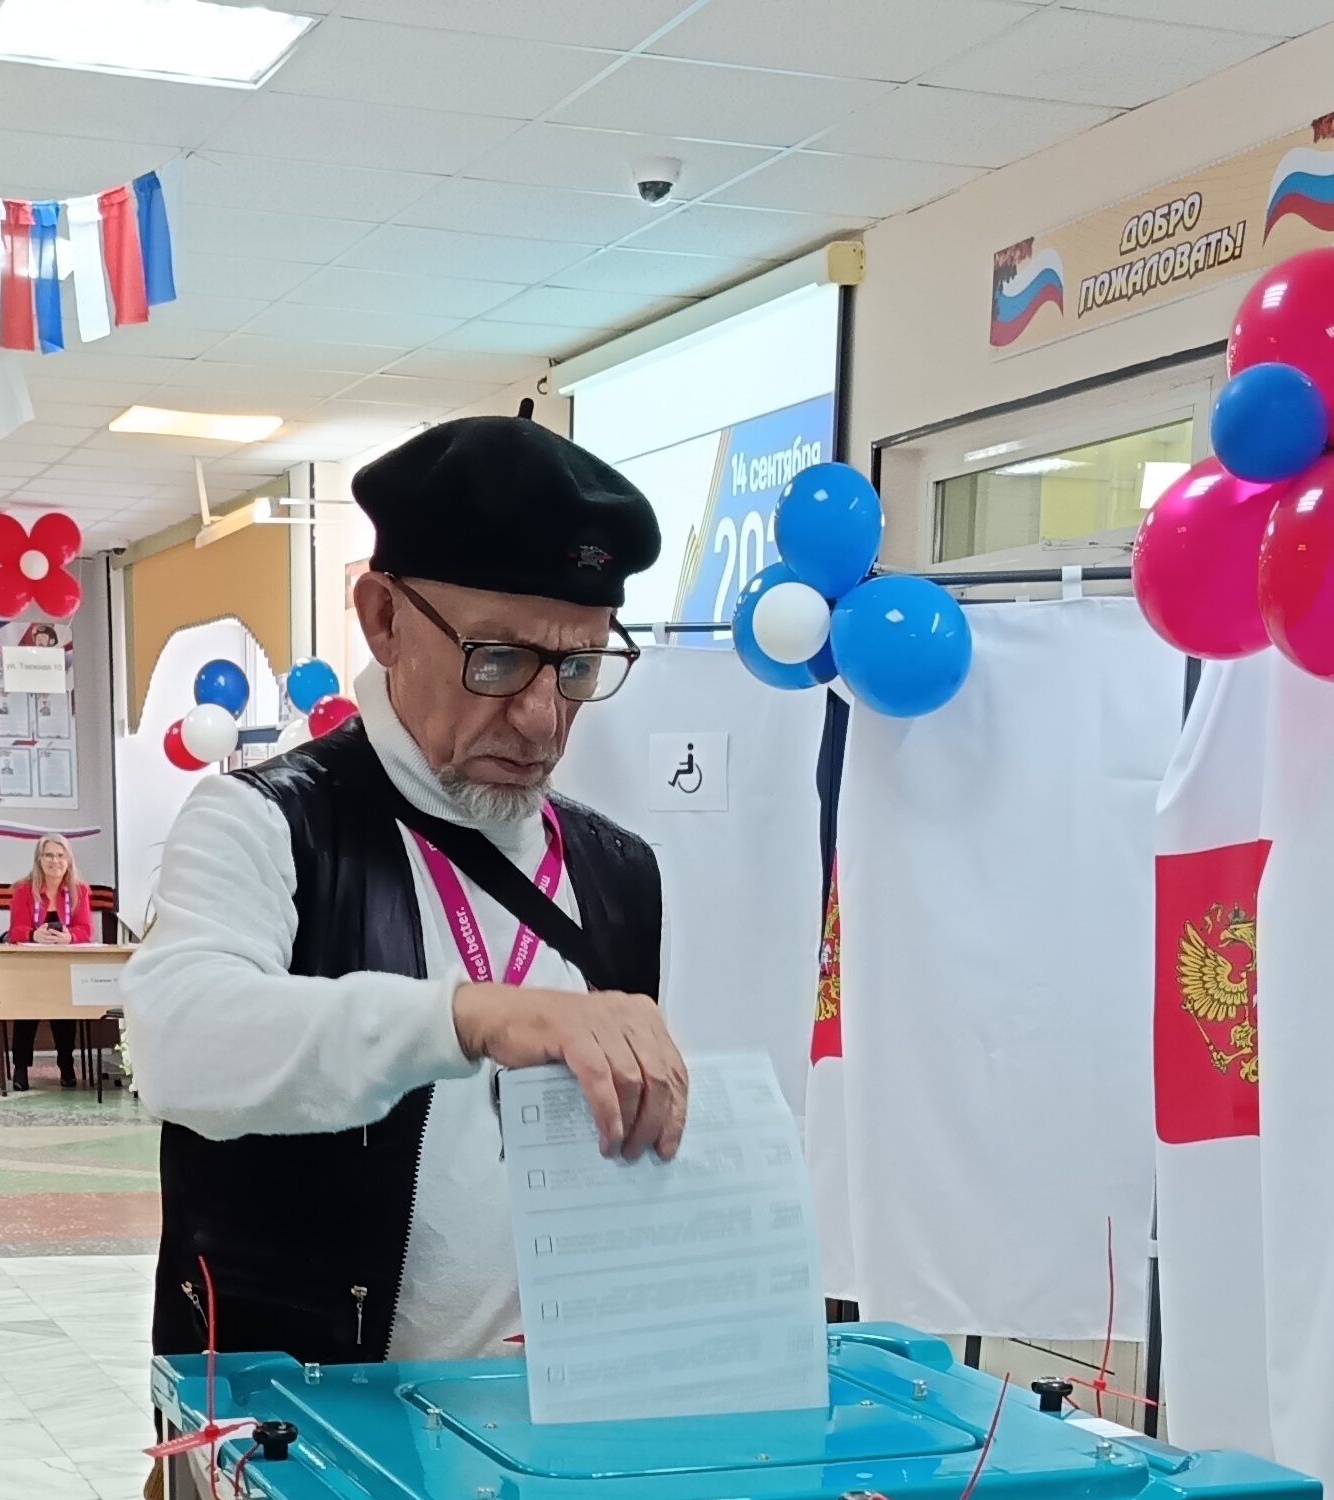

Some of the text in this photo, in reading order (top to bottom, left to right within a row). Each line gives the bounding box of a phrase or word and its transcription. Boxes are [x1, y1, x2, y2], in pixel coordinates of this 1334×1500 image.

[1120, 191, 1202, 256] ДОБРО
[1078, 220, 1246, 318] ПОЖАЛОВАТЬ!
[731, 451, 748, 497] 14
[54, 663, 63, 671] 10
[456, 906, 489, 981] feel better.
[513, 935, 534, 972] better.
